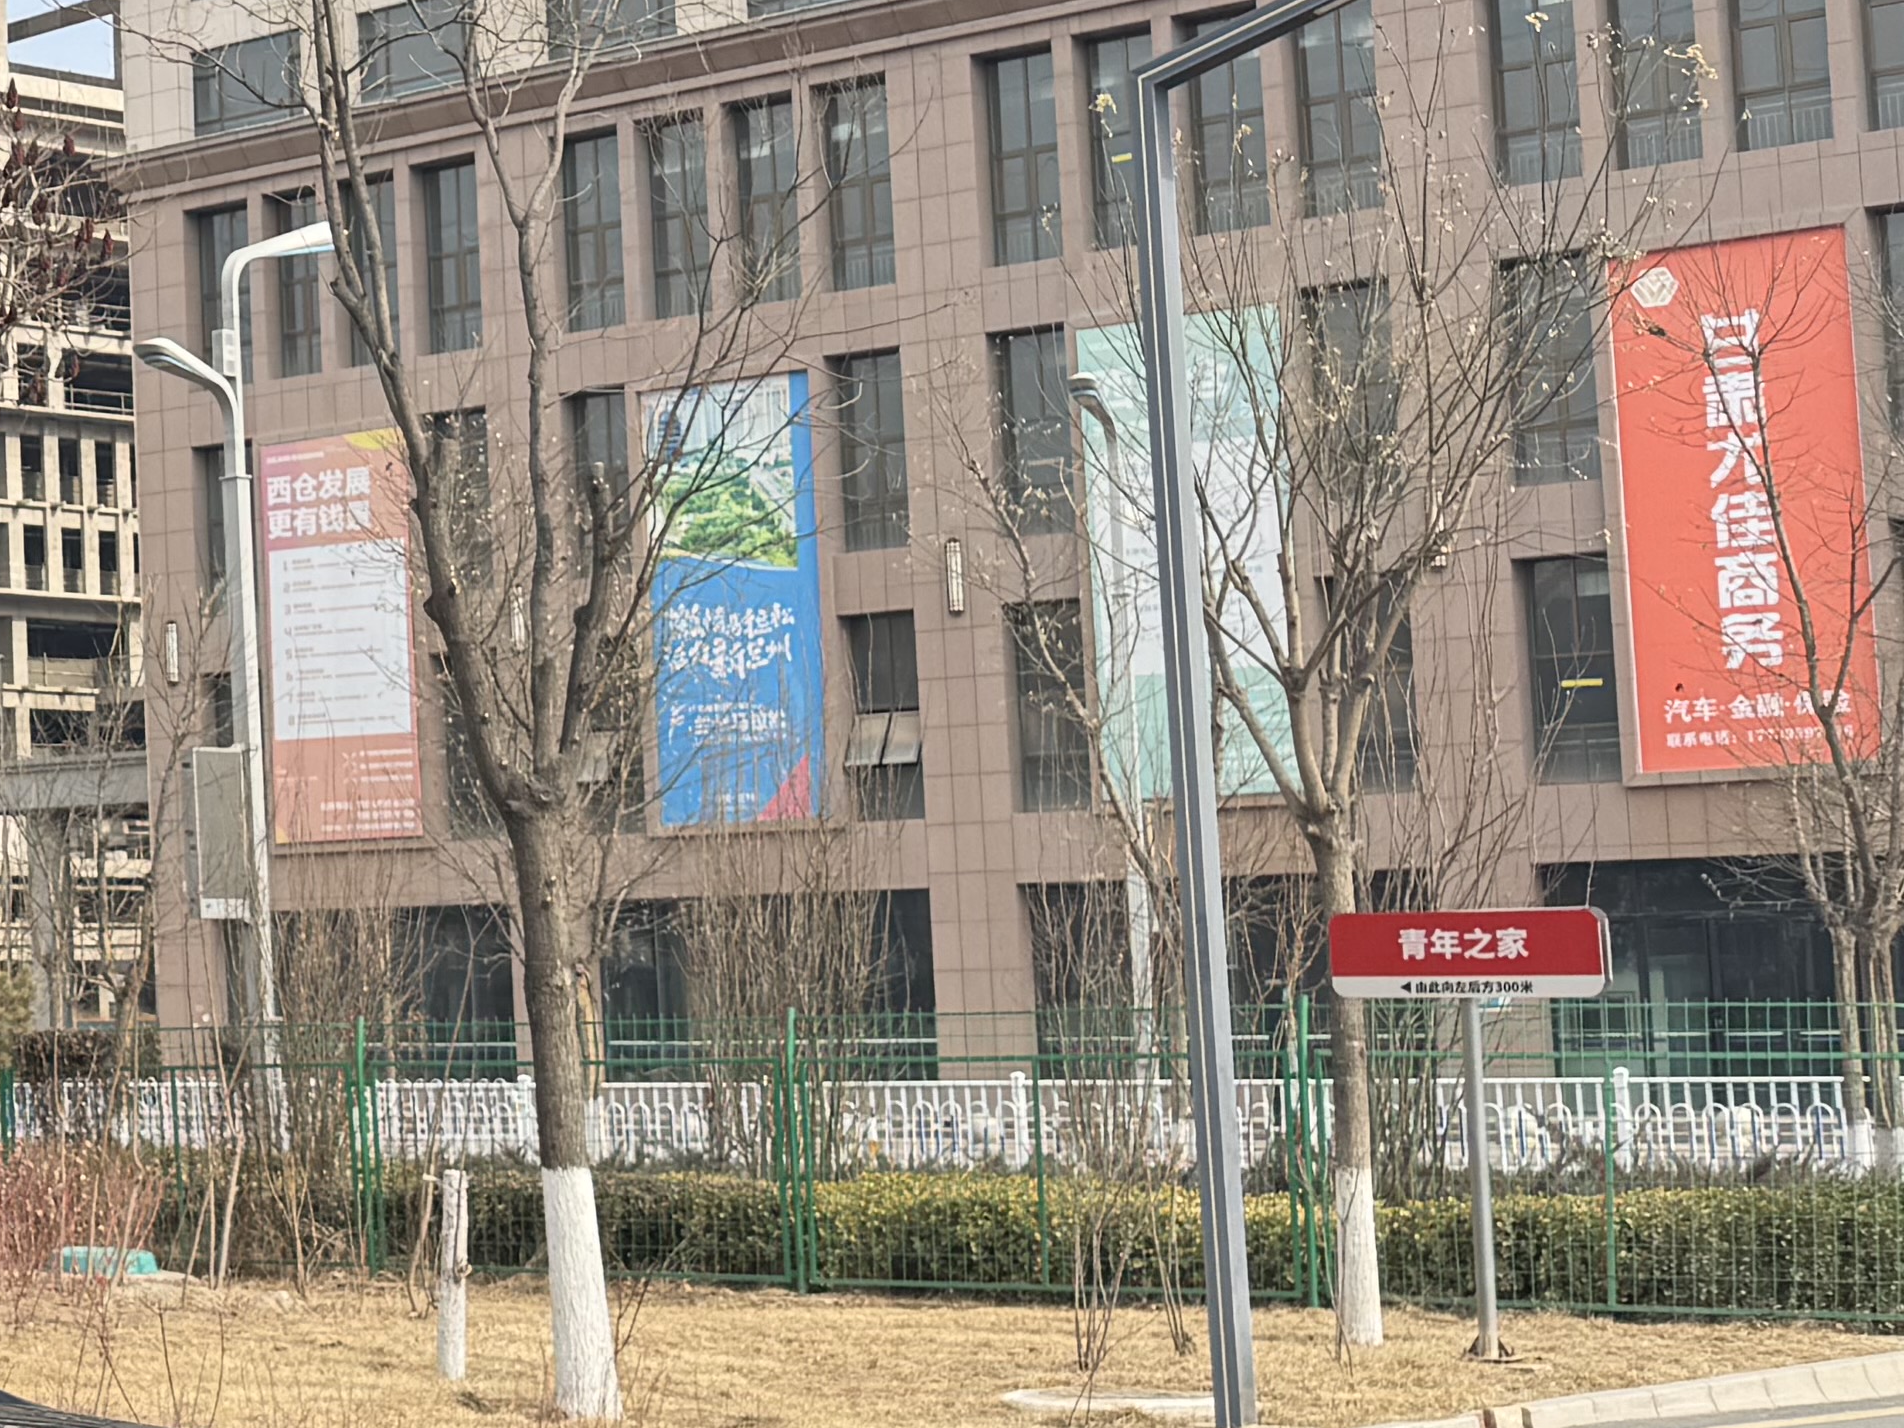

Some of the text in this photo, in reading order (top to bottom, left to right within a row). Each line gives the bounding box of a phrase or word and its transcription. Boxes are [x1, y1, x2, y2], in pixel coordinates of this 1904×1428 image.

[267, 466, 370, 506] 西仓发展
[1398, 927, 1529, 960] 青年之家
[1415, 980, 1533, 994] 由此向左后方300米
